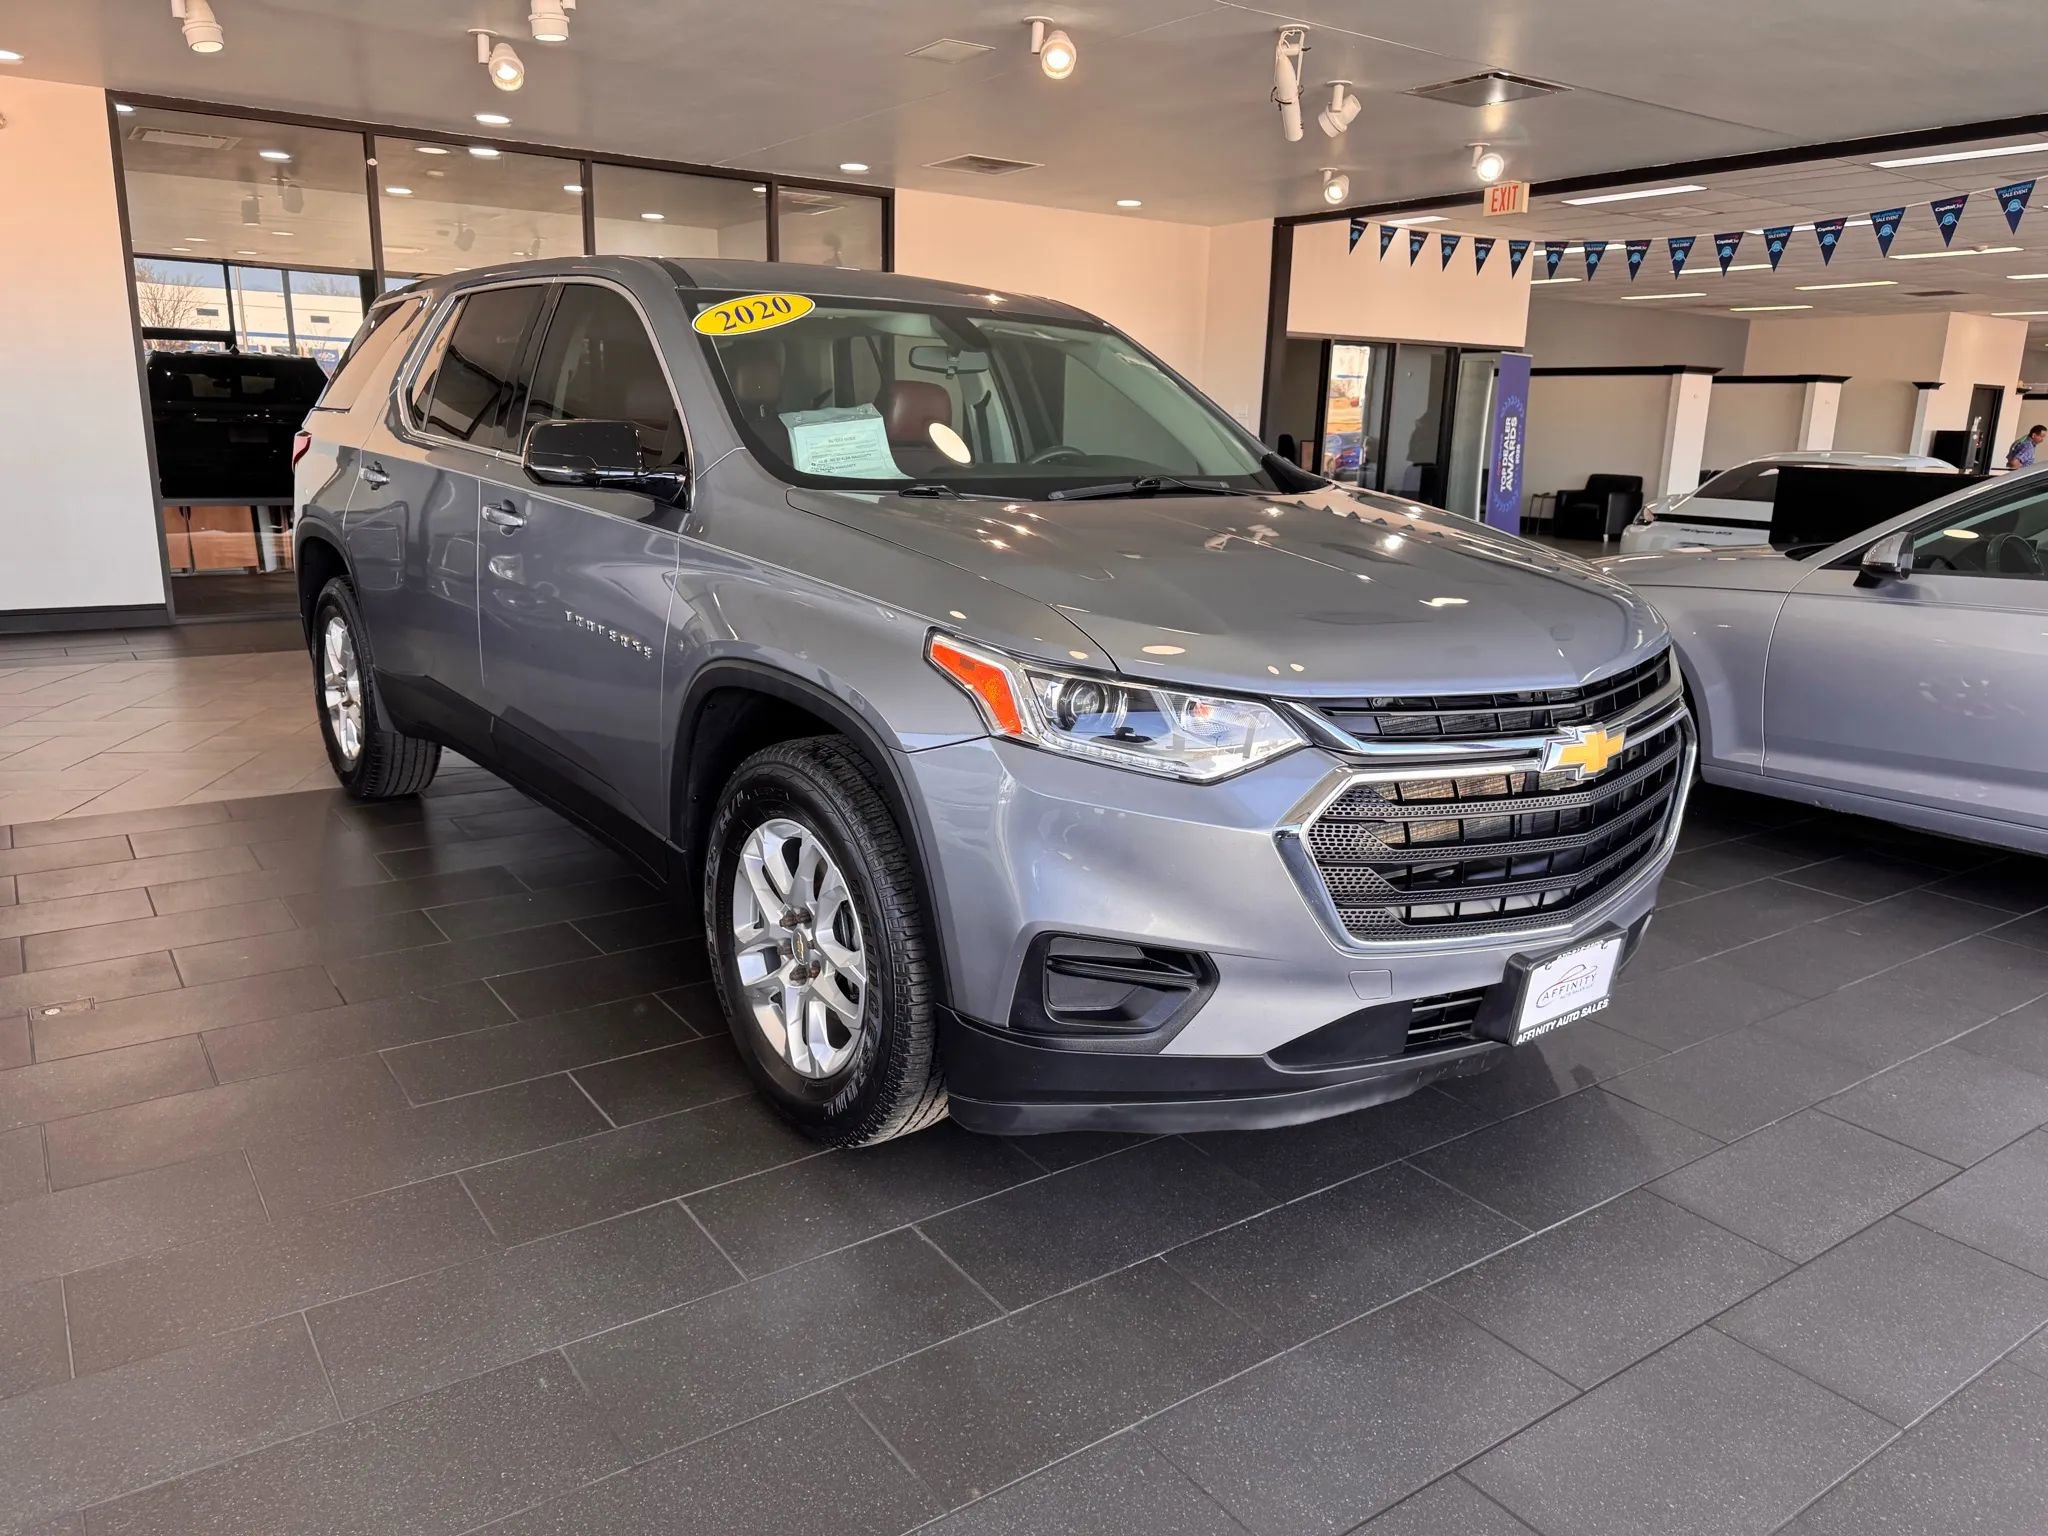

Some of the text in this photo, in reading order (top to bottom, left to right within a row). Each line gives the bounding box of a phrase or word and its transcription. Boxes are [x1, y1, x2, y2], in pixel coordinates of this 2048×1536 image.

[1491, 185, 1519, 212] EXIT
[714, 296, 792, 331] 2020
[1502, 417, 1511, 467] DEALER
[1506, 416, 1518, 491] AWARDS
[1542, 973, 1597, 1001] AFFINITY
[1516, 998, 1609, 1045] AFFINITY AUTO SALES
